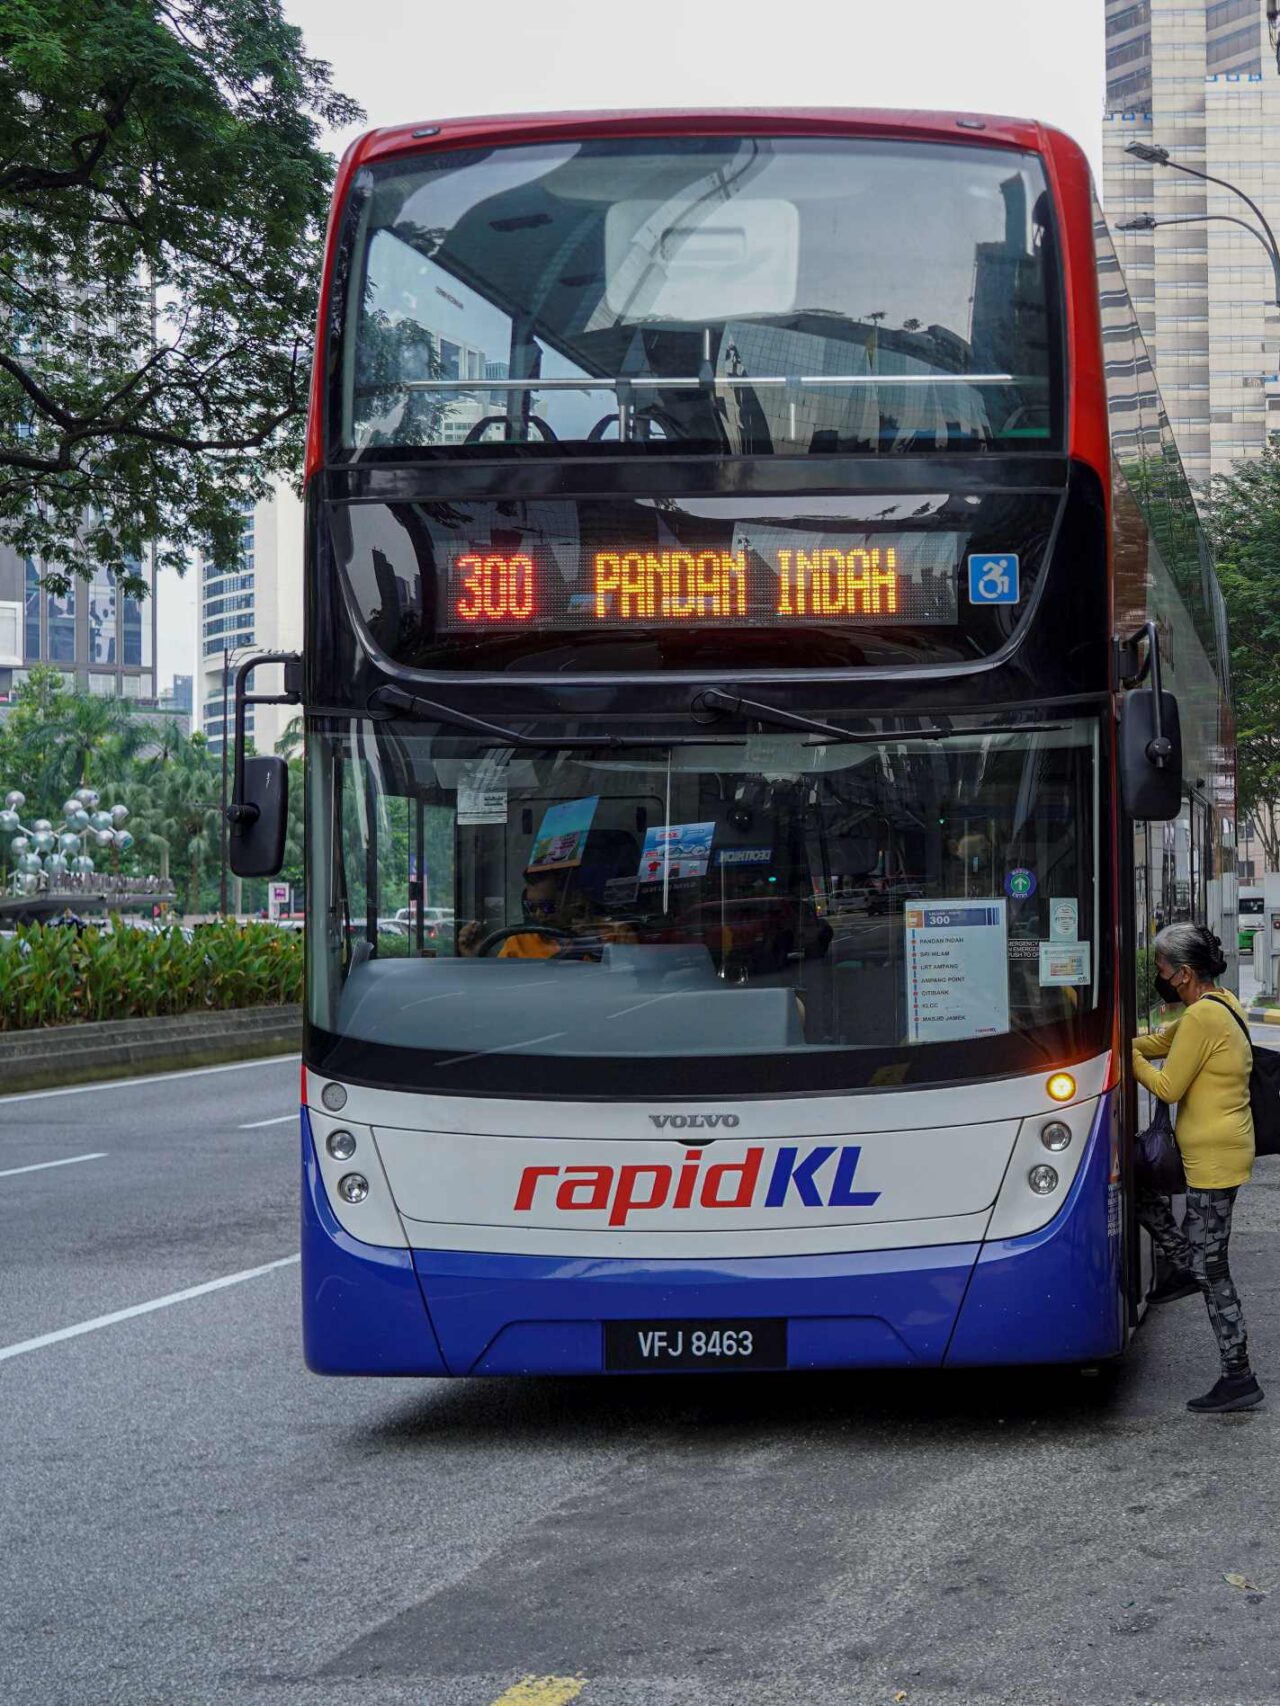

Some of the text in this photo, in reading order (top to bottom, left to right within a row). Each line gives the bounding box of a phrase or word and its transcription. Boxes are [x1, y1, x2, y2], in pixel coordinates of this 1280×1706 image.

[457, 549, 897, 619] 300 PANDAN INDAH
[929, 915, 950, 925] 300
[648, 1113, 740, 1128] VOLVO
[513, 1146, 882, 1226] rapidKL
[637, 1330, 754, 1358] VFJ 8463
